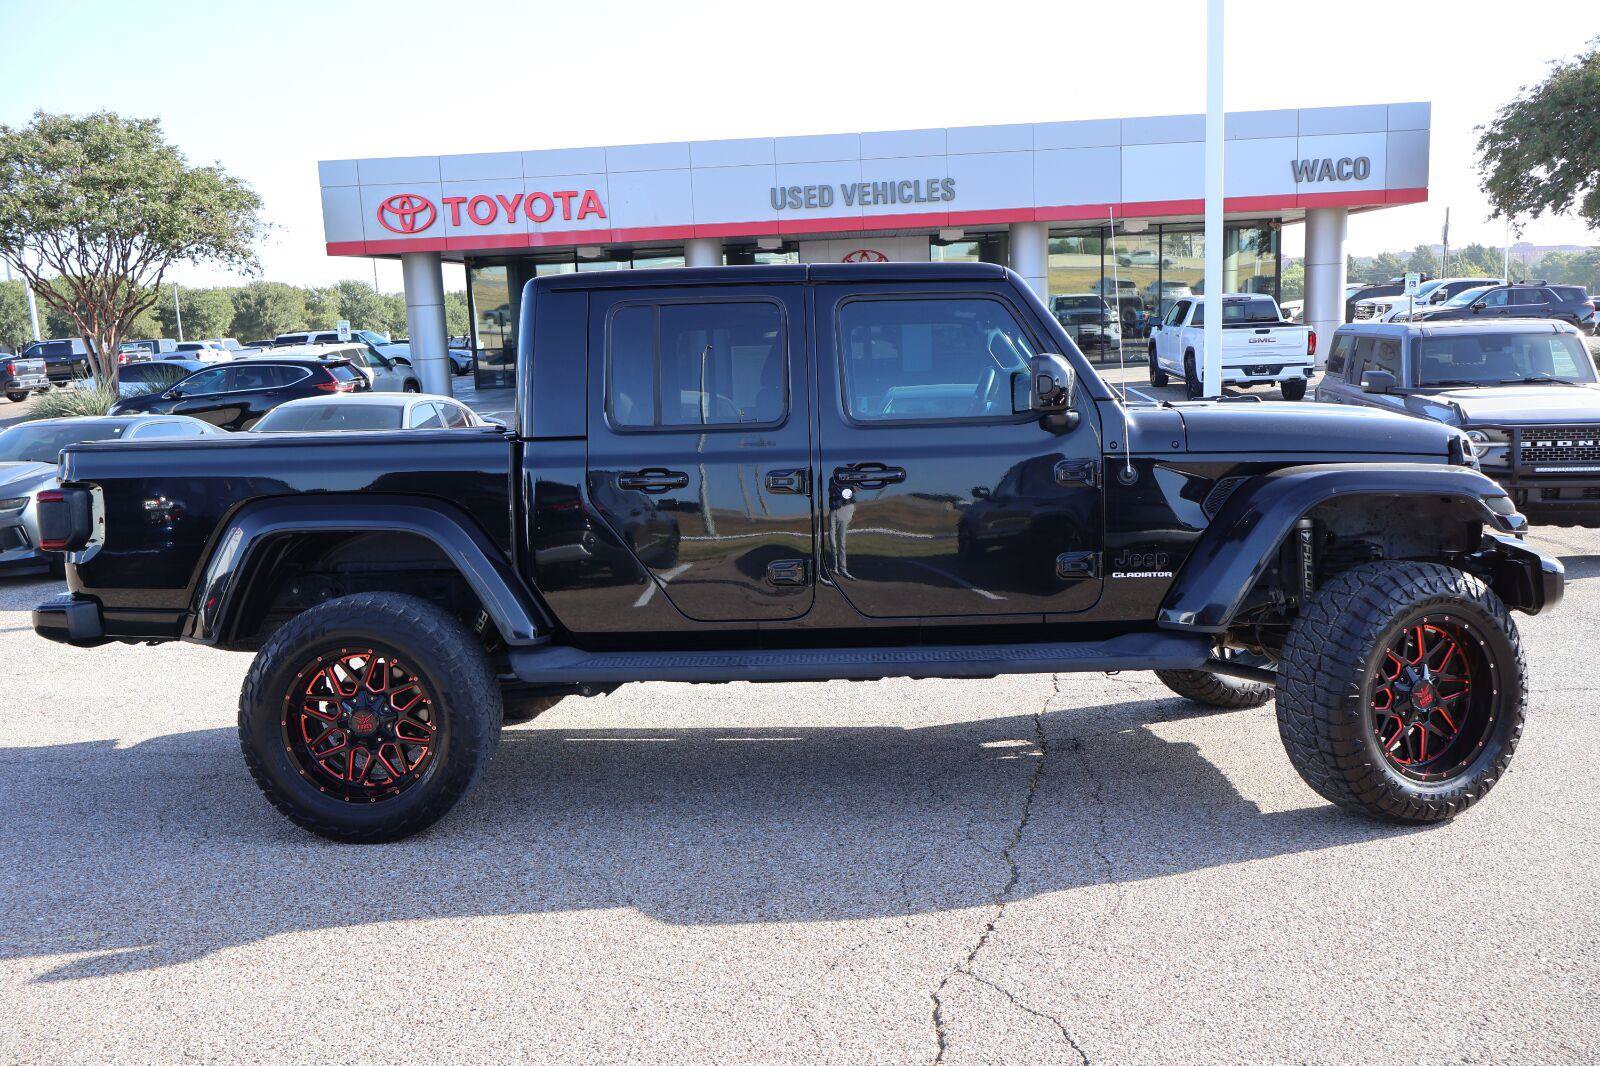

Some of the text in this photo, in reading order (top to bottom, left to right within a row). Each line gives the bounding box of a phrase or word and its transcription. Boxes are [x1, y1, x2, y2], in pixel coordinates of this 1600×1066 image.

[1290, 156, 1371, 183] WACO
[770, 177, 956, 210] USED VEHICLES
[442, 189, 606, 226] TOYOTA
[1520, 440, 1600, 448] BRON
[1114, 549, 1169, 570] Jeep
